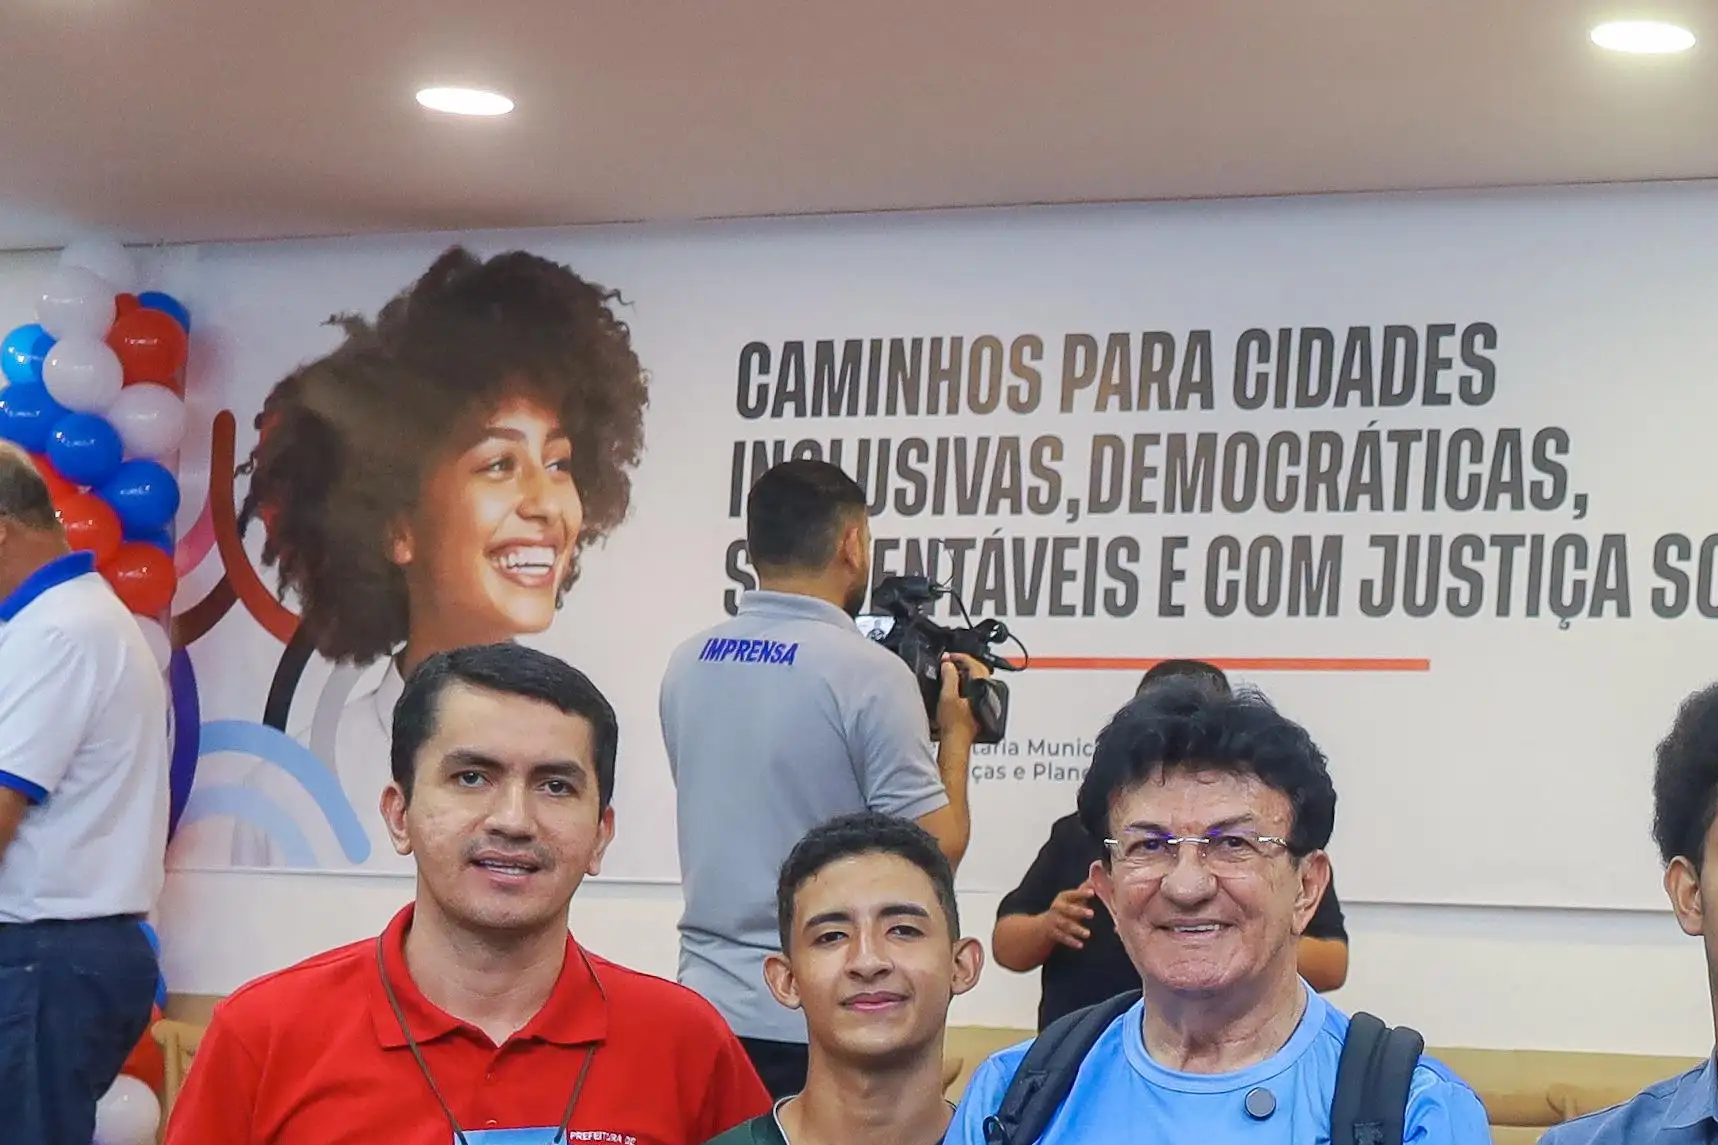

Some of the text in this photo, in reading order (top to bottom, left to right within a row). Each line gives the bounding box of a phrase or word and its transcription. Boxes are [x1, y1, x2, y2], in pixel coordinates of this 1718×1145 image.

[737, 322, 1497, 419] CAMINHOS PARA CIDADES
[729, 436, 1080, 524] IUSIVAS,
[724, 529, 1140, 618] SENTÁVEIS
[1157, 535, 1189, 616] E
[1206, 534, 1343, 617] COM
[1360, 534, 1632, 630] JUSTIÇA
[699, 638, 799, 666] IMPRENSA
